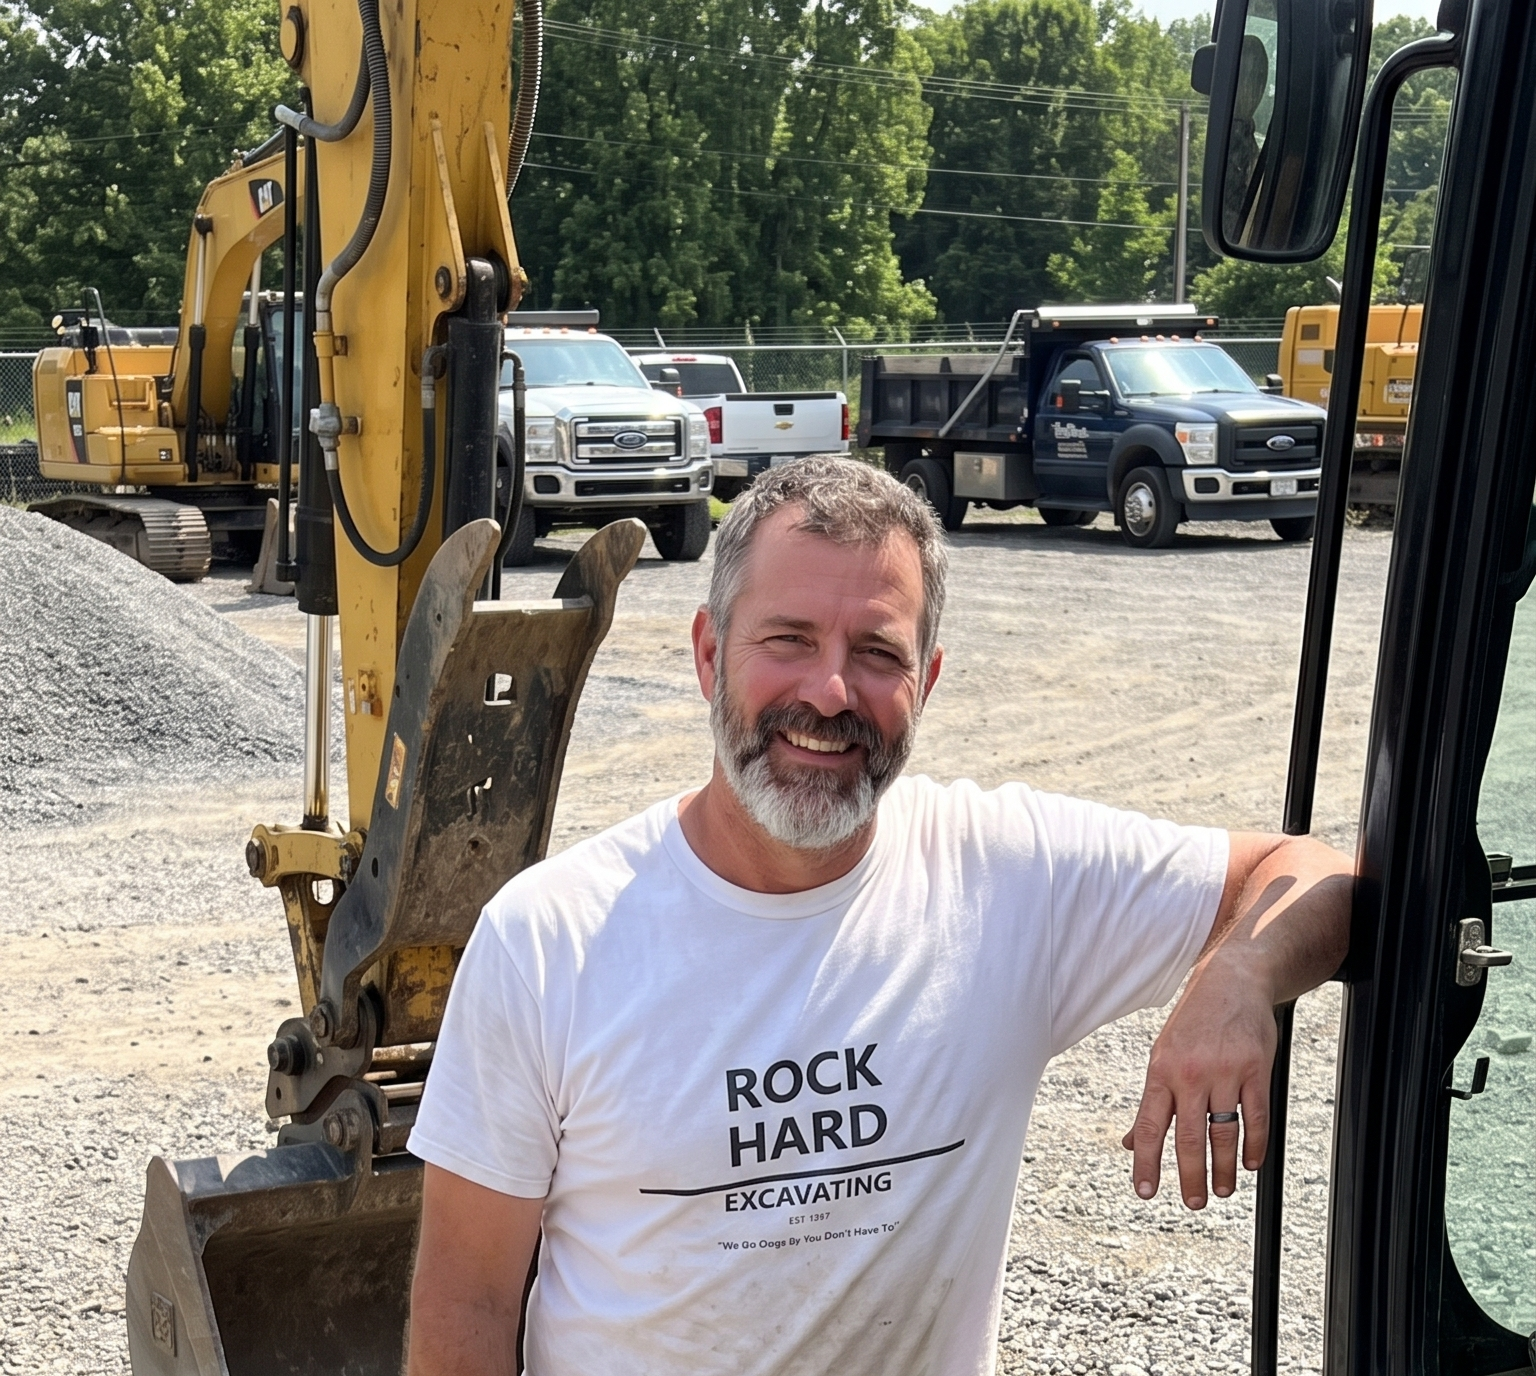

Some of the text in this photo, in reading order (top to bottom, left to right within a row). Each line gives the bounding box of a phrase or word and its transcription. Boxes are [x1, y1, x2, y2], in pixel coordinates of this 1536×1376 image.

[725, 1042, 883, 1112] ROCK
[729, 1103, 888, 1168] HARD
[725, 1171, 893, 1213] EXCAVATING
[741, 1240, 757, 1250] Go
[788, 1236, 802, 1247] By
[803, 1234, 822, 1244] You
[824, 1228, 852, 1241] Don't
[853, 1226, 880, 1237] Have
[788, 1215, 806, 1226] EST
